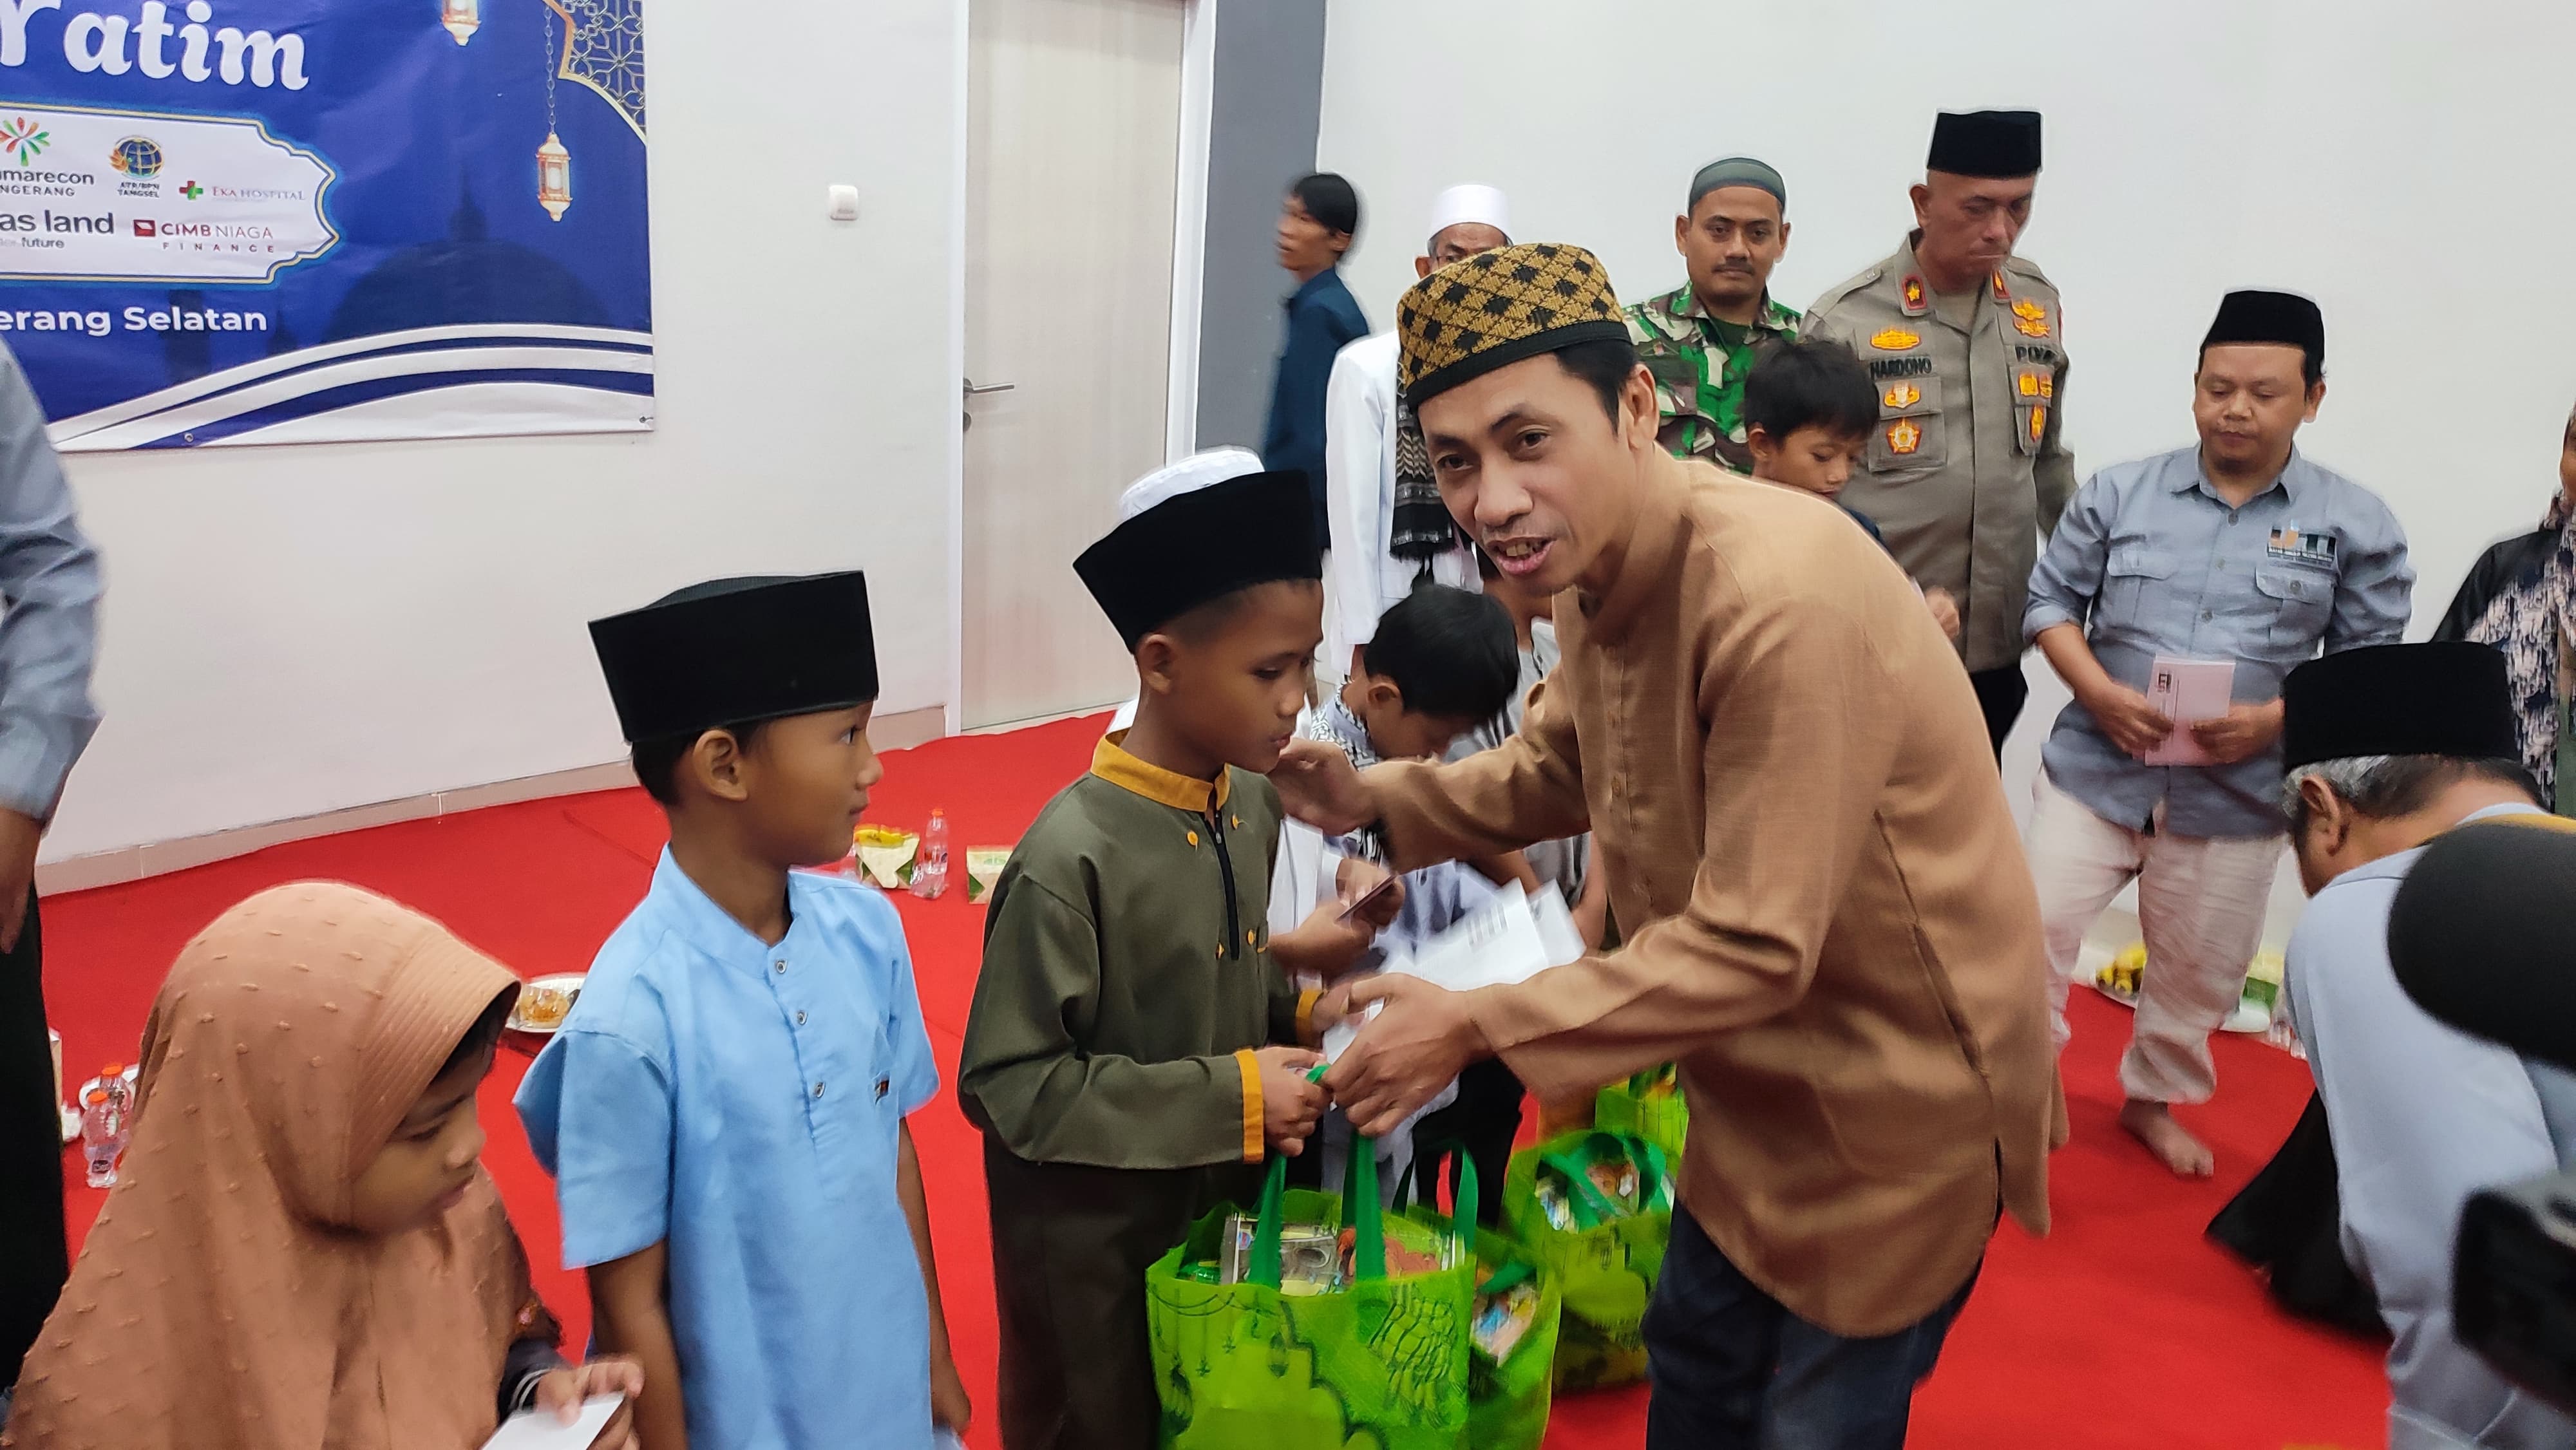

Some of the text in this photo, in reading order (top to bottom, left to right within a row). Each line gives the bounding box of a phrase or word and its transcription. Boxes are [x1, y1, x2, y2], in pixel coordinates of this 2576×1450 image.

[0, 170, 94, 185] marecon
[240, 189, 305, 201] HOSPITAL
[0, 209, 114, 234] as land
[161, 223, 273, 239] CIMB NIAGA
[21, 237, 64, 249] future
[163, 242, 274, 252] FINANCE
[123, 306, 267, 331] Selatan
